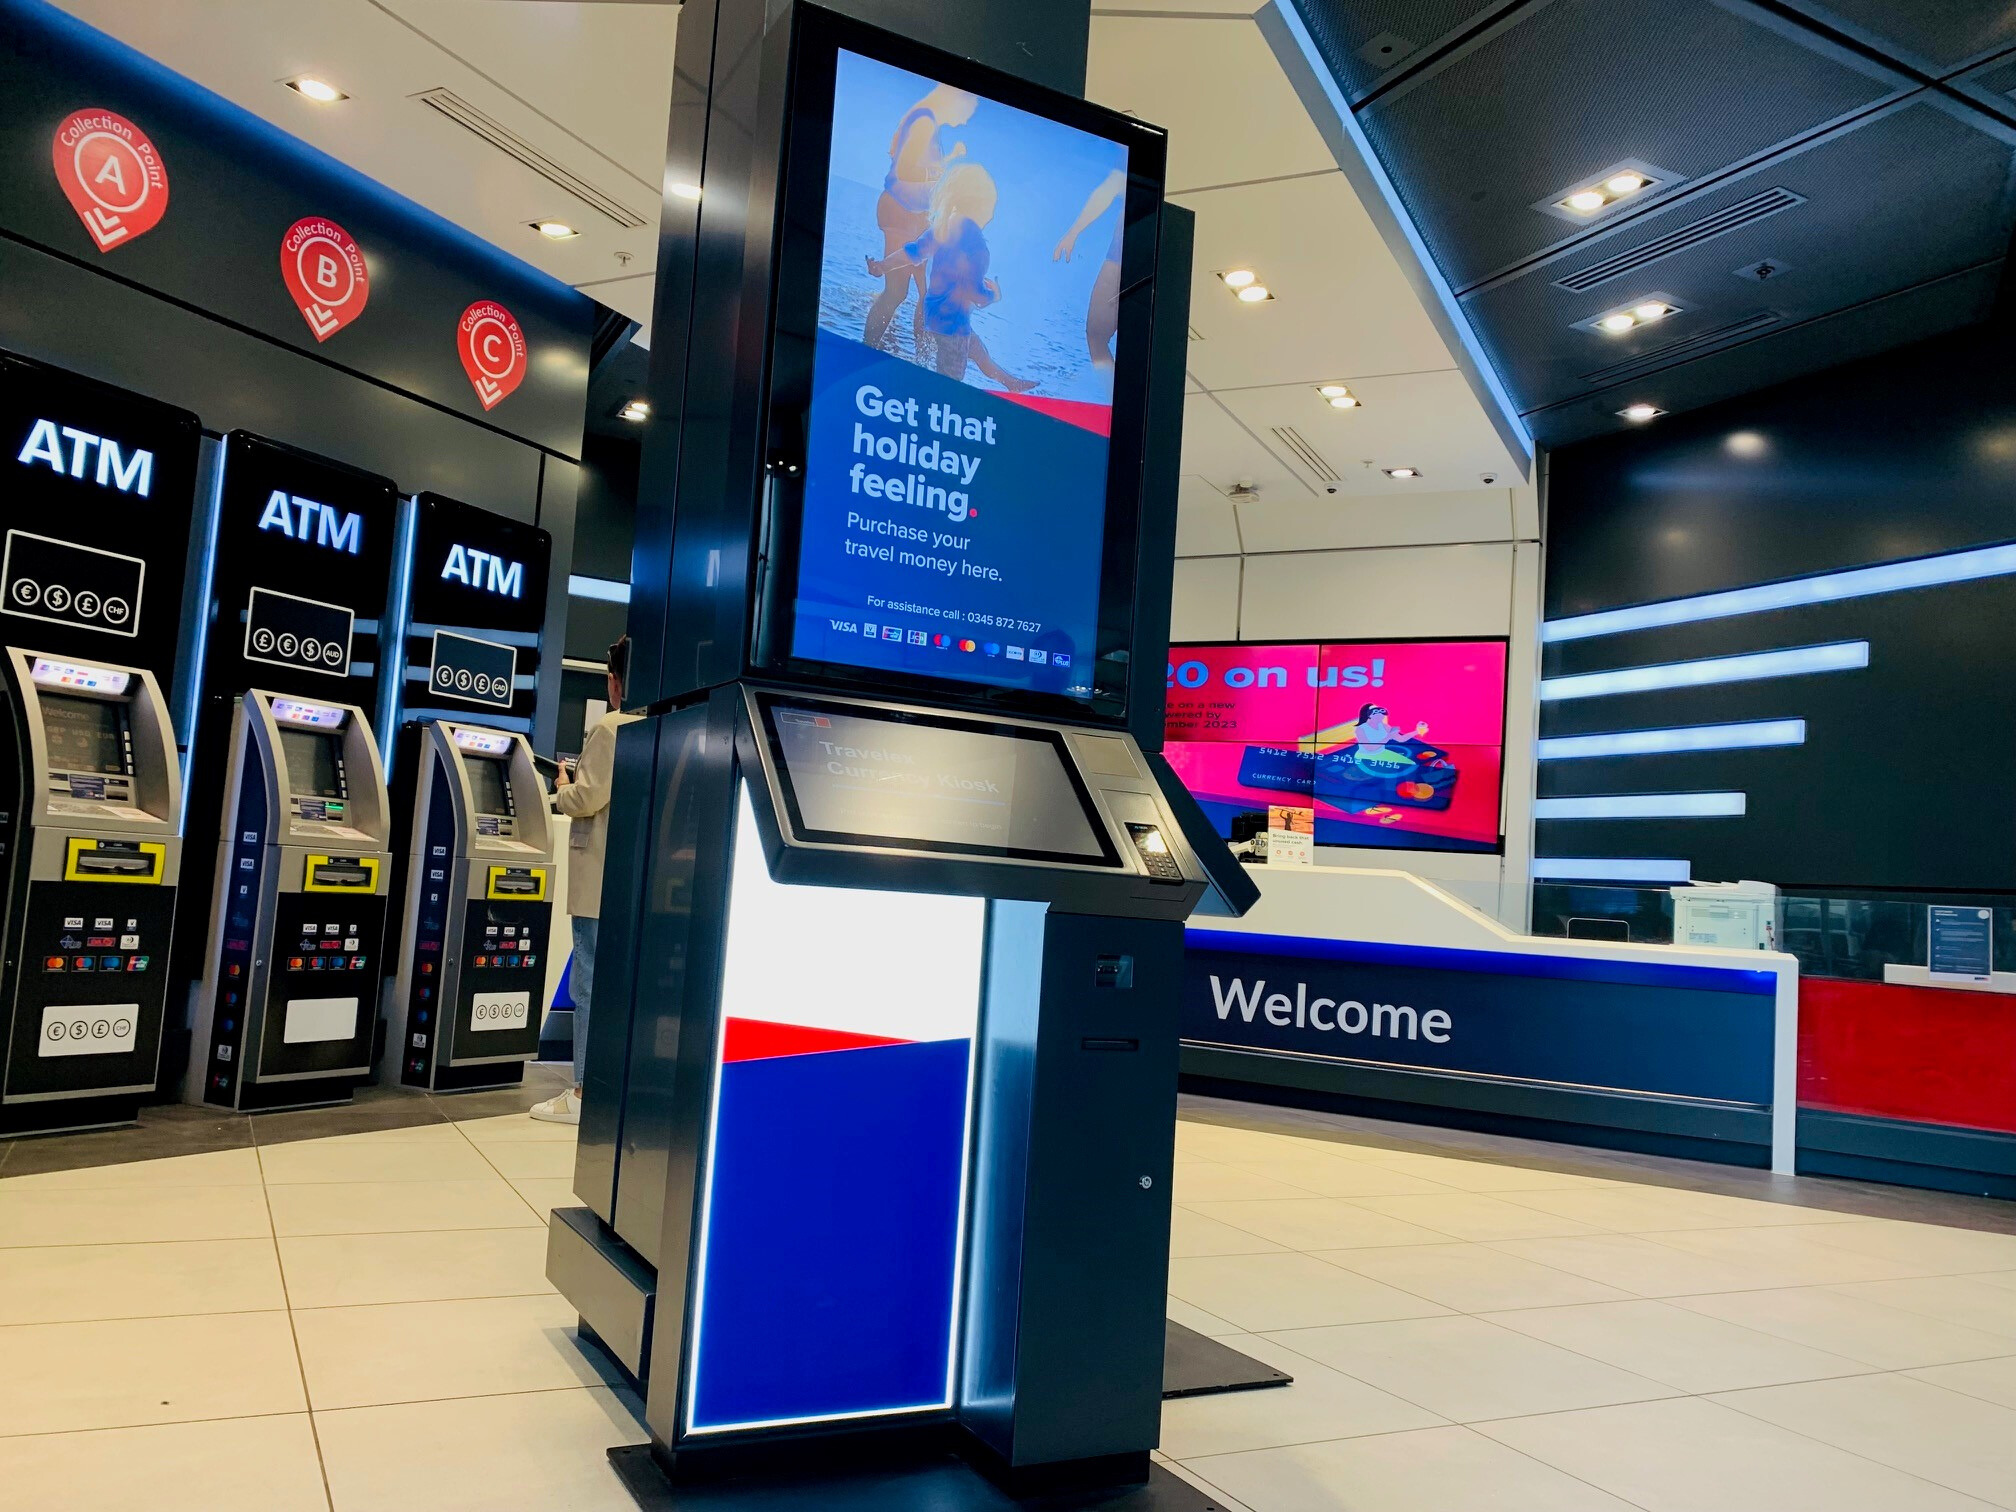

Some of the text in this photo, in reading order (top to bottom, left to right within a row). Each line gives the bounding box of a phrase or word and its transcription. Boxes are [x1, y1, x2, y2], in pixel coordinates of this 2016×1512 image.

[60, 115, 164, 190] Collection Point
[94, 155, 127, 195] A
[286, 222, 366, 283] Collection Point
[316, 254, 338, 288] B
[462, 305, 524, 358] Collection Point
[483, 334, 502, 363] C
[855, 384, 997, 445] Get that
[17, 418, 154, 498] ATM
[852, 422, 982, 485] holiday
[849, 462, 978, 523] feeling.
[257, 489, 360, 554] ATM
[847, 511, 971, 551] Purchase your
[440, 543, 523, 599] ATM
[844, 538, 1003, 582] travel money here.
[20, 584, 125, 616] € $ £ CHF
[867, 595, 885, 608] For
[887, 600, 941, 617] assistance
[942, 609, 960, 620] call
[967, 612, 994, 626] 0345
[995, 616, 1015, 629] 872
[1016, 620, 1041, 633] 7627
[829, 619, 858, 634] VISA
[259, 633, 340, 659] £ € $ AUD
[1223, 666, 1288, 688] on
[1306, 658, 1385, 688] us!
[1203, 720, 1237, 729] 2023
[1206, 711, 1221, 720] by
[818, 740, 915, 764] Travelex
[1259, 747, 1400, 770] 5412 7512 3412 3456
[826, 761, 999, 794] Currcy Kiosk
[1252, 772, 1292, 783] CURRENCY
[1209, 974, 1452, 1044] Welcome
[53, 1026, 60, 1036] €
[75, 1025, 83, 1036] $
[97, 1024, 104, 1034] £
